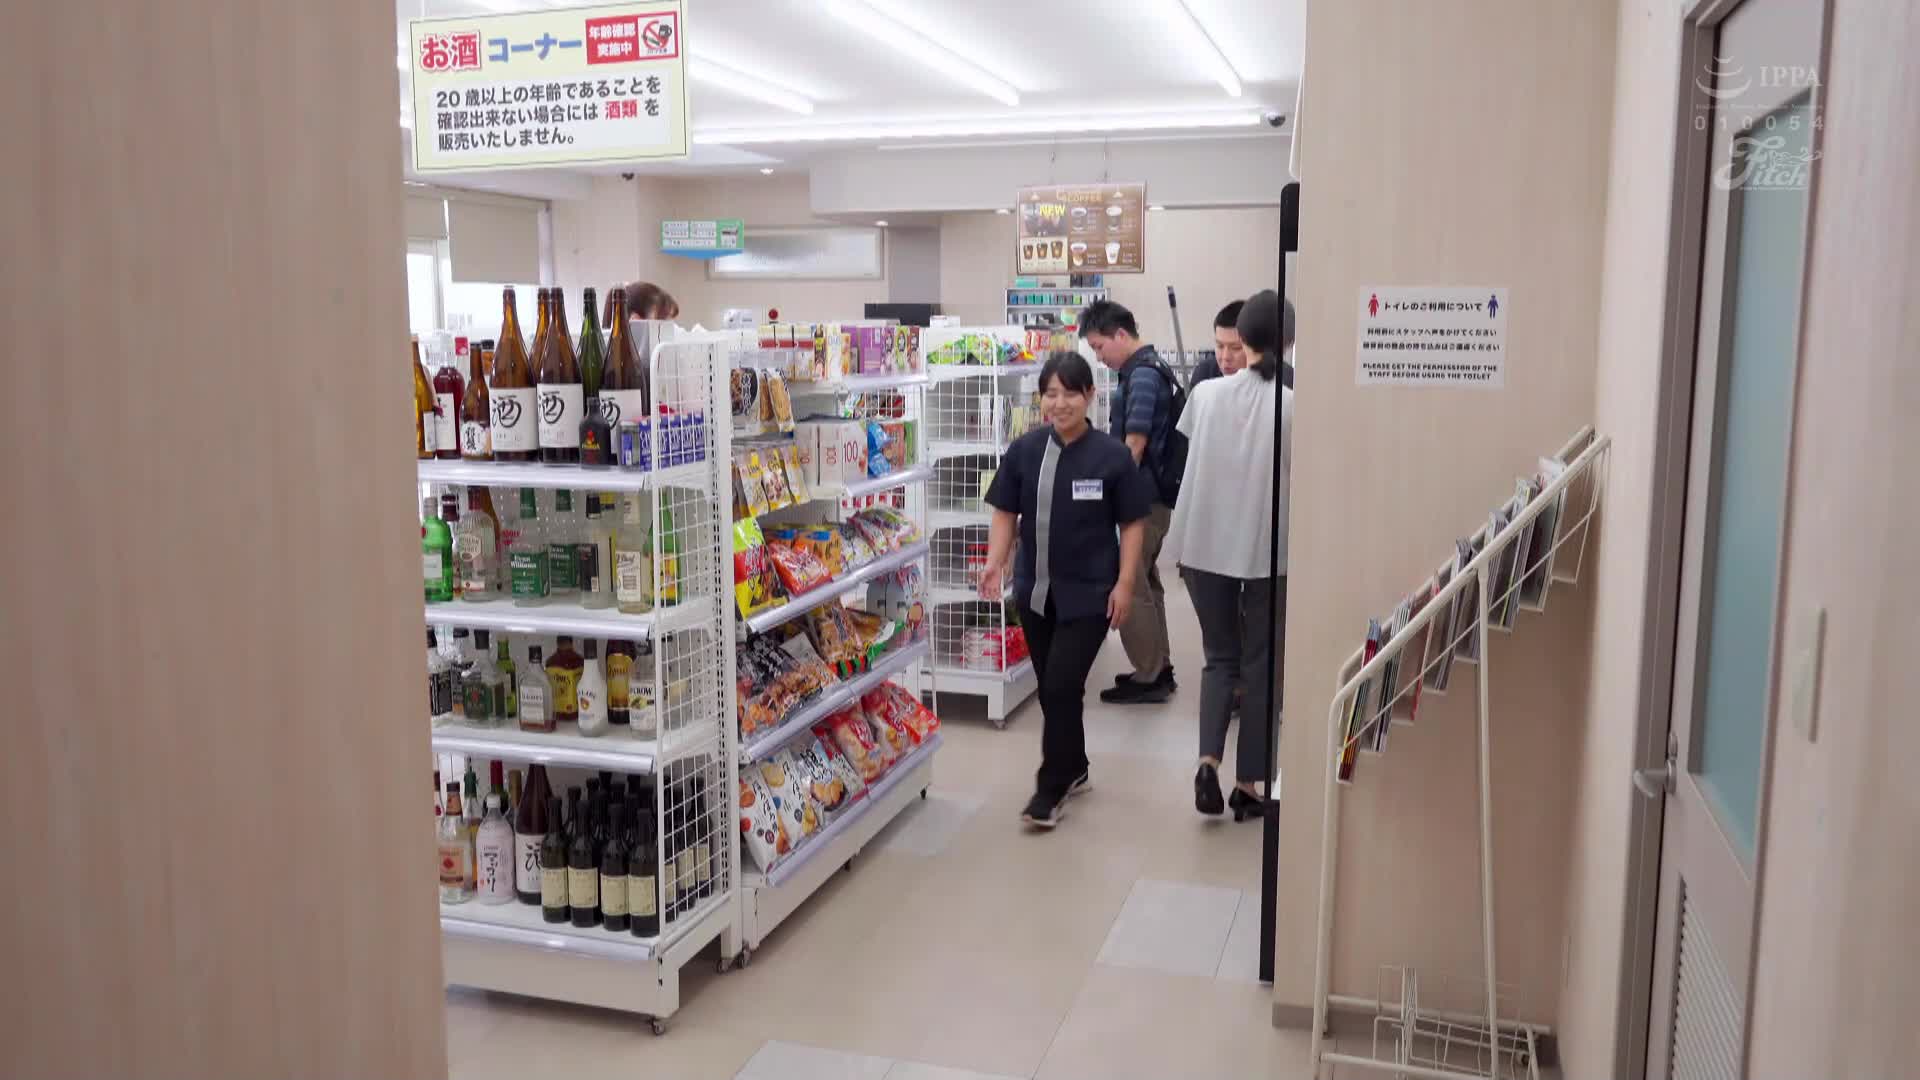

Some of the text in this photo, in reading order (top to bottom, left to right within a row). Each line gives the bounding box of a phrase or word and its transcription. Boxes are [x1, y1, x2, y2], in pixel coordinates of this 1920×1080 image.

[588, 23, 636, 40] 年齢確認
[421, 33, 582, 70] お酒 コーナー
[597, 42, 632, 57] 実施中
[437, 76, 661, 108] 20 歳以上の年齢であることを
[437, 100, 659, 130] 確認出来ない場合には 酒類 を
[438, 127, 574, 152] 販売いたしません。
[1040, 203, 1066, 217] NEW
[1385, 302, 1483, 312] トイレのご利用について
[1448, 372, 1461, 380] THE
[844, 440, 858, 463] 100
